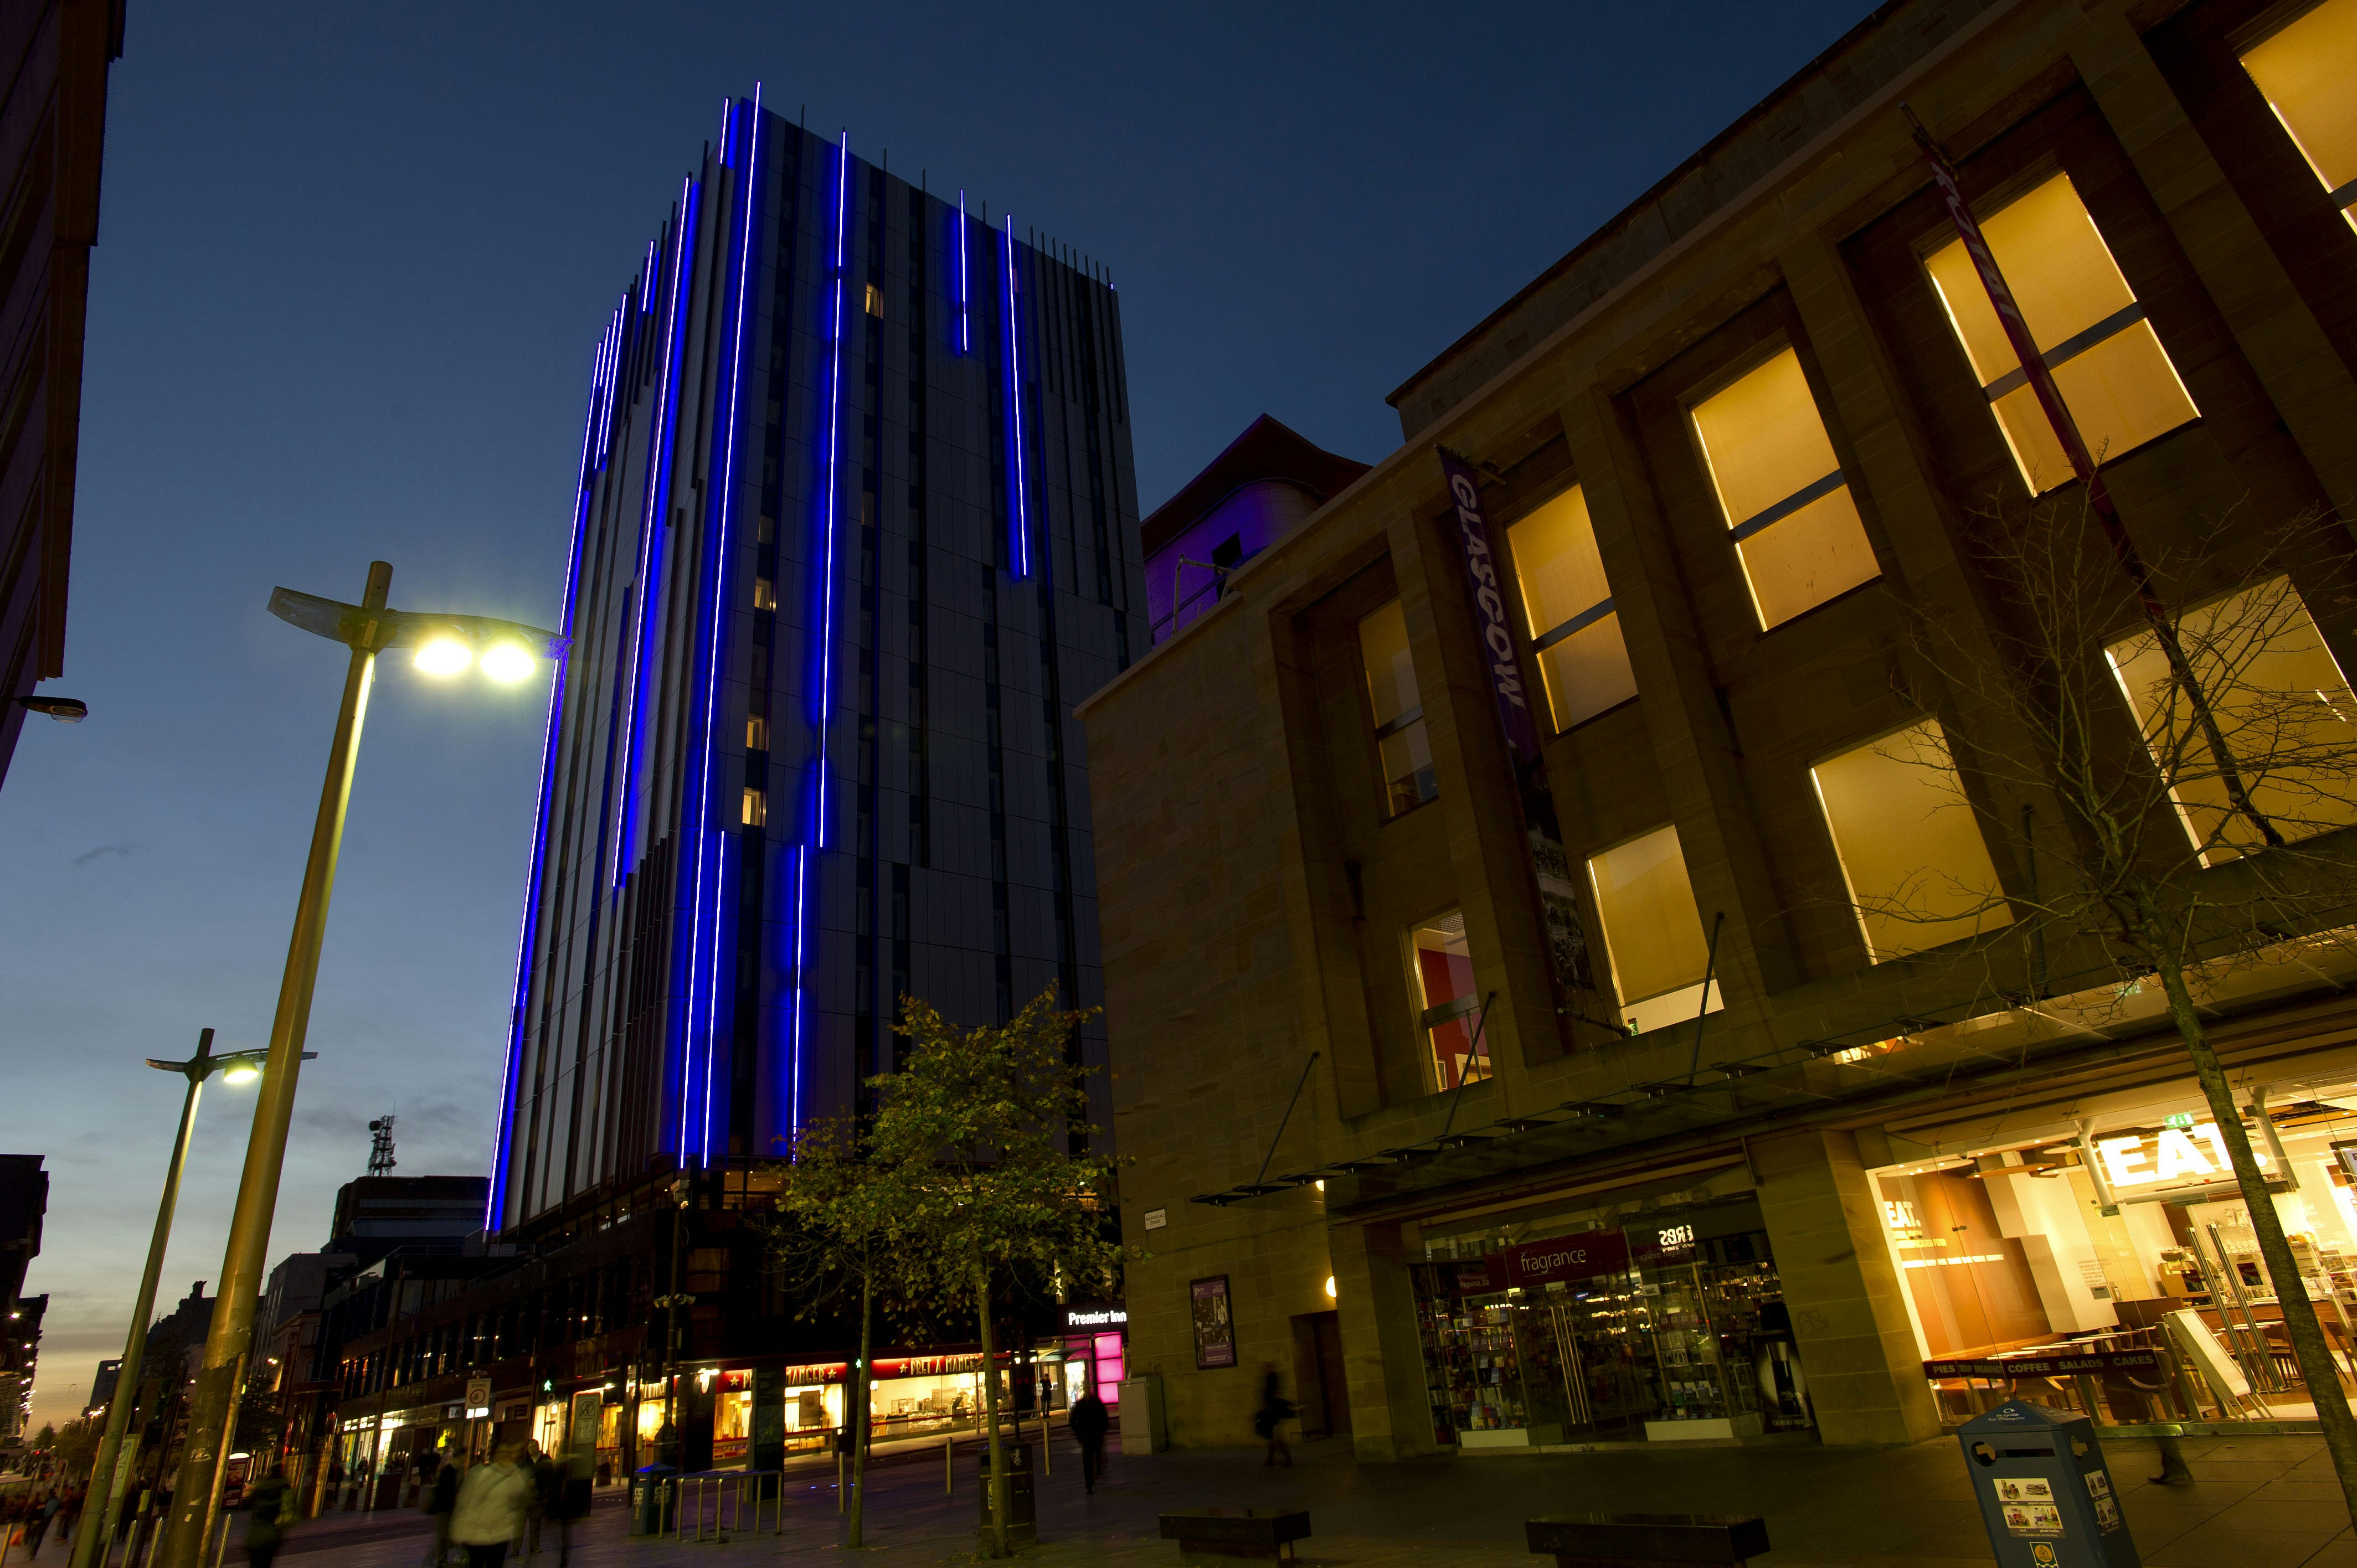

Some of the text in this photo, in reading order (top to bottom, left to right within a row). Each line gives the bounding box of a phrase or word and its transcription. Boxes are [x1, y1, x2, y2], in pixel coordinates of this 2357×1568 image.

[1452, 474, 1526, 709] GLASGOW
[1883, 1201, 1921, 1227] EAT.
[1520, 1249, 1587, 1273] fragrance
[1068, 1310, 1127, 1325] Premier Inn
[910, 1359, 932, 1375] PRET
[935, 1358, 941, 1374] A
[1933, 1365, 1955, 1374] PIES
[1974, 1364, 2004, 1374] BREAKFAST
[2008, 1361, 2051, 1374] COFFEE
[2058, 1358, 2104, 1370] SALADS
[2113, 1355, 2154, 1367] CAKES
